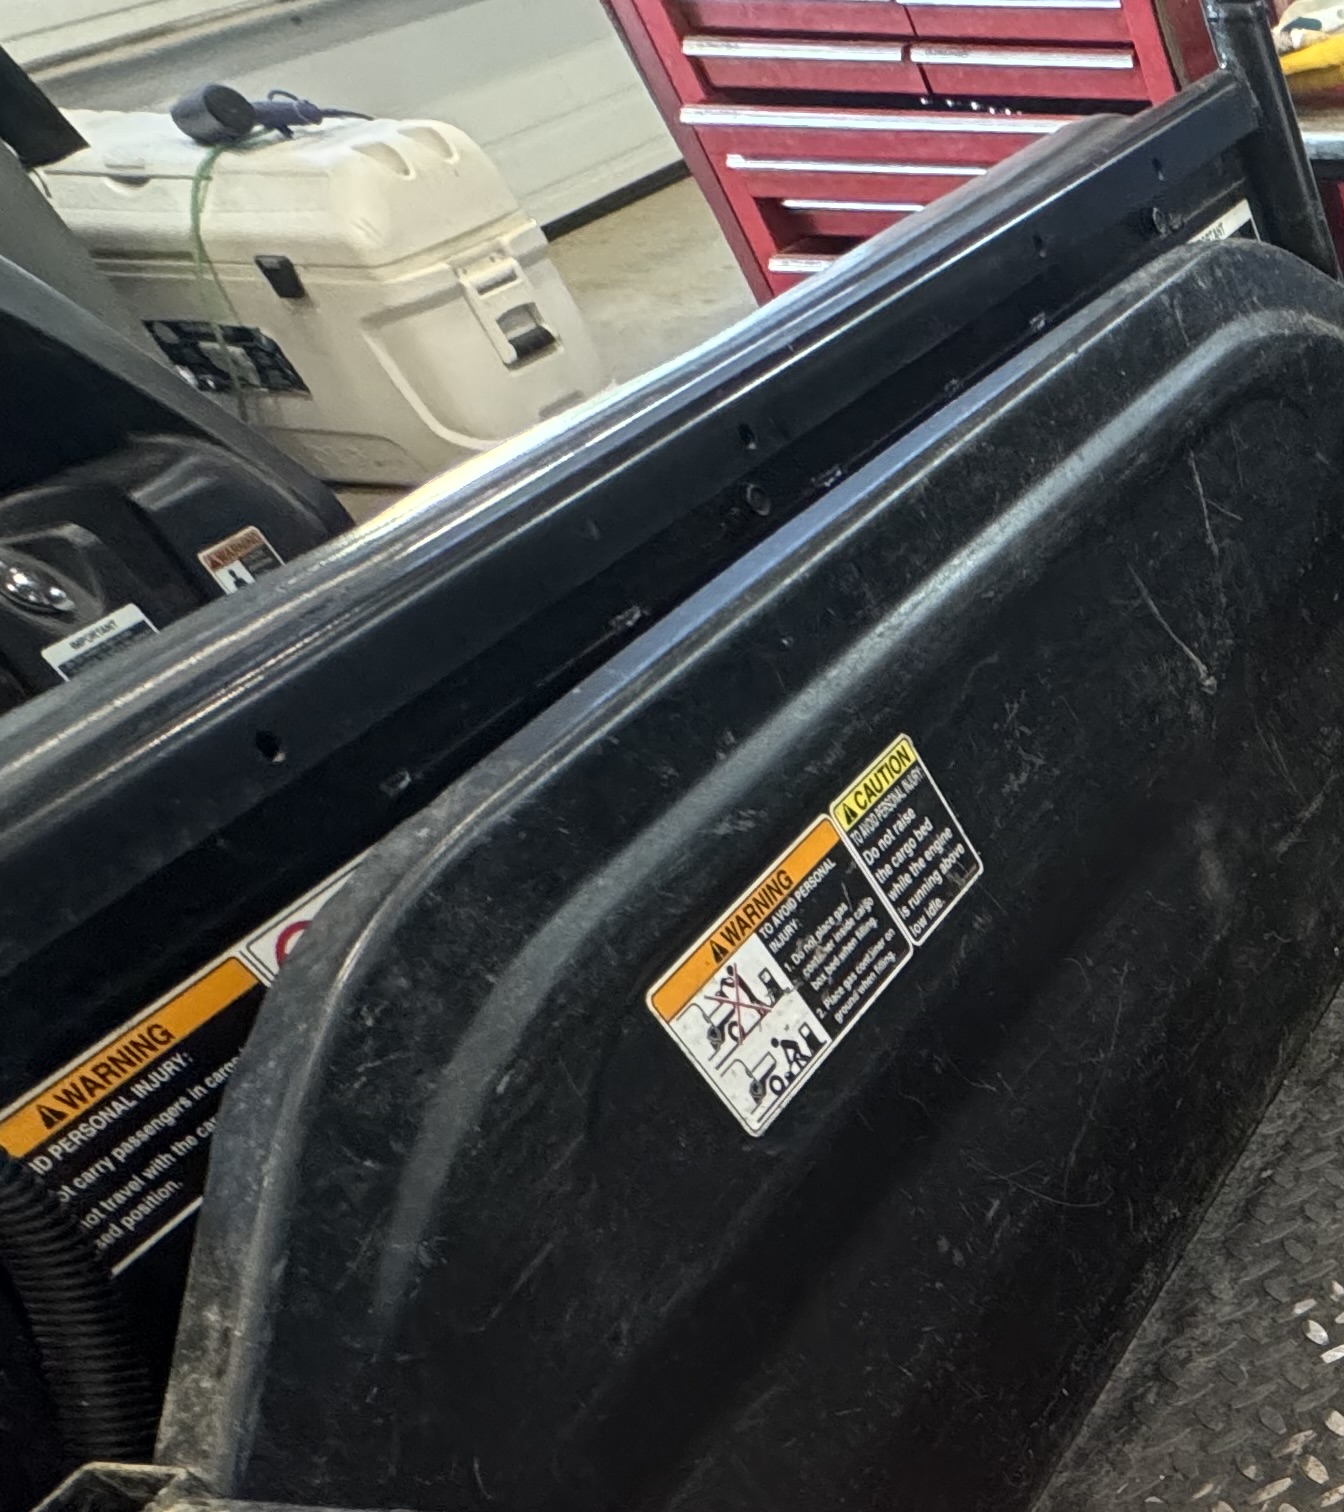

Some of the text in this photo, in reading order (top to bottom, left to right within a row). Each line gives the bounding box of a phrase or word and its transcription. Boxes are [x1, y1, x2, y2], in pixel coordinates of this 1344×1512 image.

[69, 619, 119, 650] IMPORTANT
[853, 744, 912, 811] CAUTION
[849, 829, 864, 847] TO
[858, 812, 880, 839] AVOID
[874, 785, 907, 822] PERSONAL
[862, 808, 917, 865] Do not raise
[875, 816, 934, 884] the cargo bed
[888, 827, 953, 902] while the engine
[897, 843, 965, 920] is running above
[720, 869, 794, 946] WARNING
[759, 858, 836, 939] TO AVOID PERSONAL
[832, 917, 856, 943] inside
[853, 897, 874, 920] cargo
[909, 898, 946, 937] low idle.
[791, 951, 805, 965] Do
[803, 935, 818, 954] not
[815, 916, 836, 944] place
[834, 902, 848, 925] gas
[810, 973, 828, 991] box
[824, 955, 841, 976] bed
[838, 937, 859, 961] when
[816, 1007, 828, 1020] 2.
[823, 986, 846, 1010] Place
[843, 971, 858, 991] gas
[885, 928, 896, 941] on
[834, 989, 860, 1024] ground
[857, 971, 877, 994] when
[53, 1023, 176, 1110] WARNING
[47, 1095, 136, 1161] PERSONAL
[130, 1052, 195, 1099] INJURY:
[57, 1185, 78, 1202] ot
[73, 1156, 117, 1190] carry
[111, 1096, 193, 1163] passengers
[186, 1086, 209, 1101] in
[99, 1174, 146, 1212] travel
[141, 1150, 177, 1181] with
[170, 1135, 199, 1157] the
[121, 1180, 184, 1231] position.
